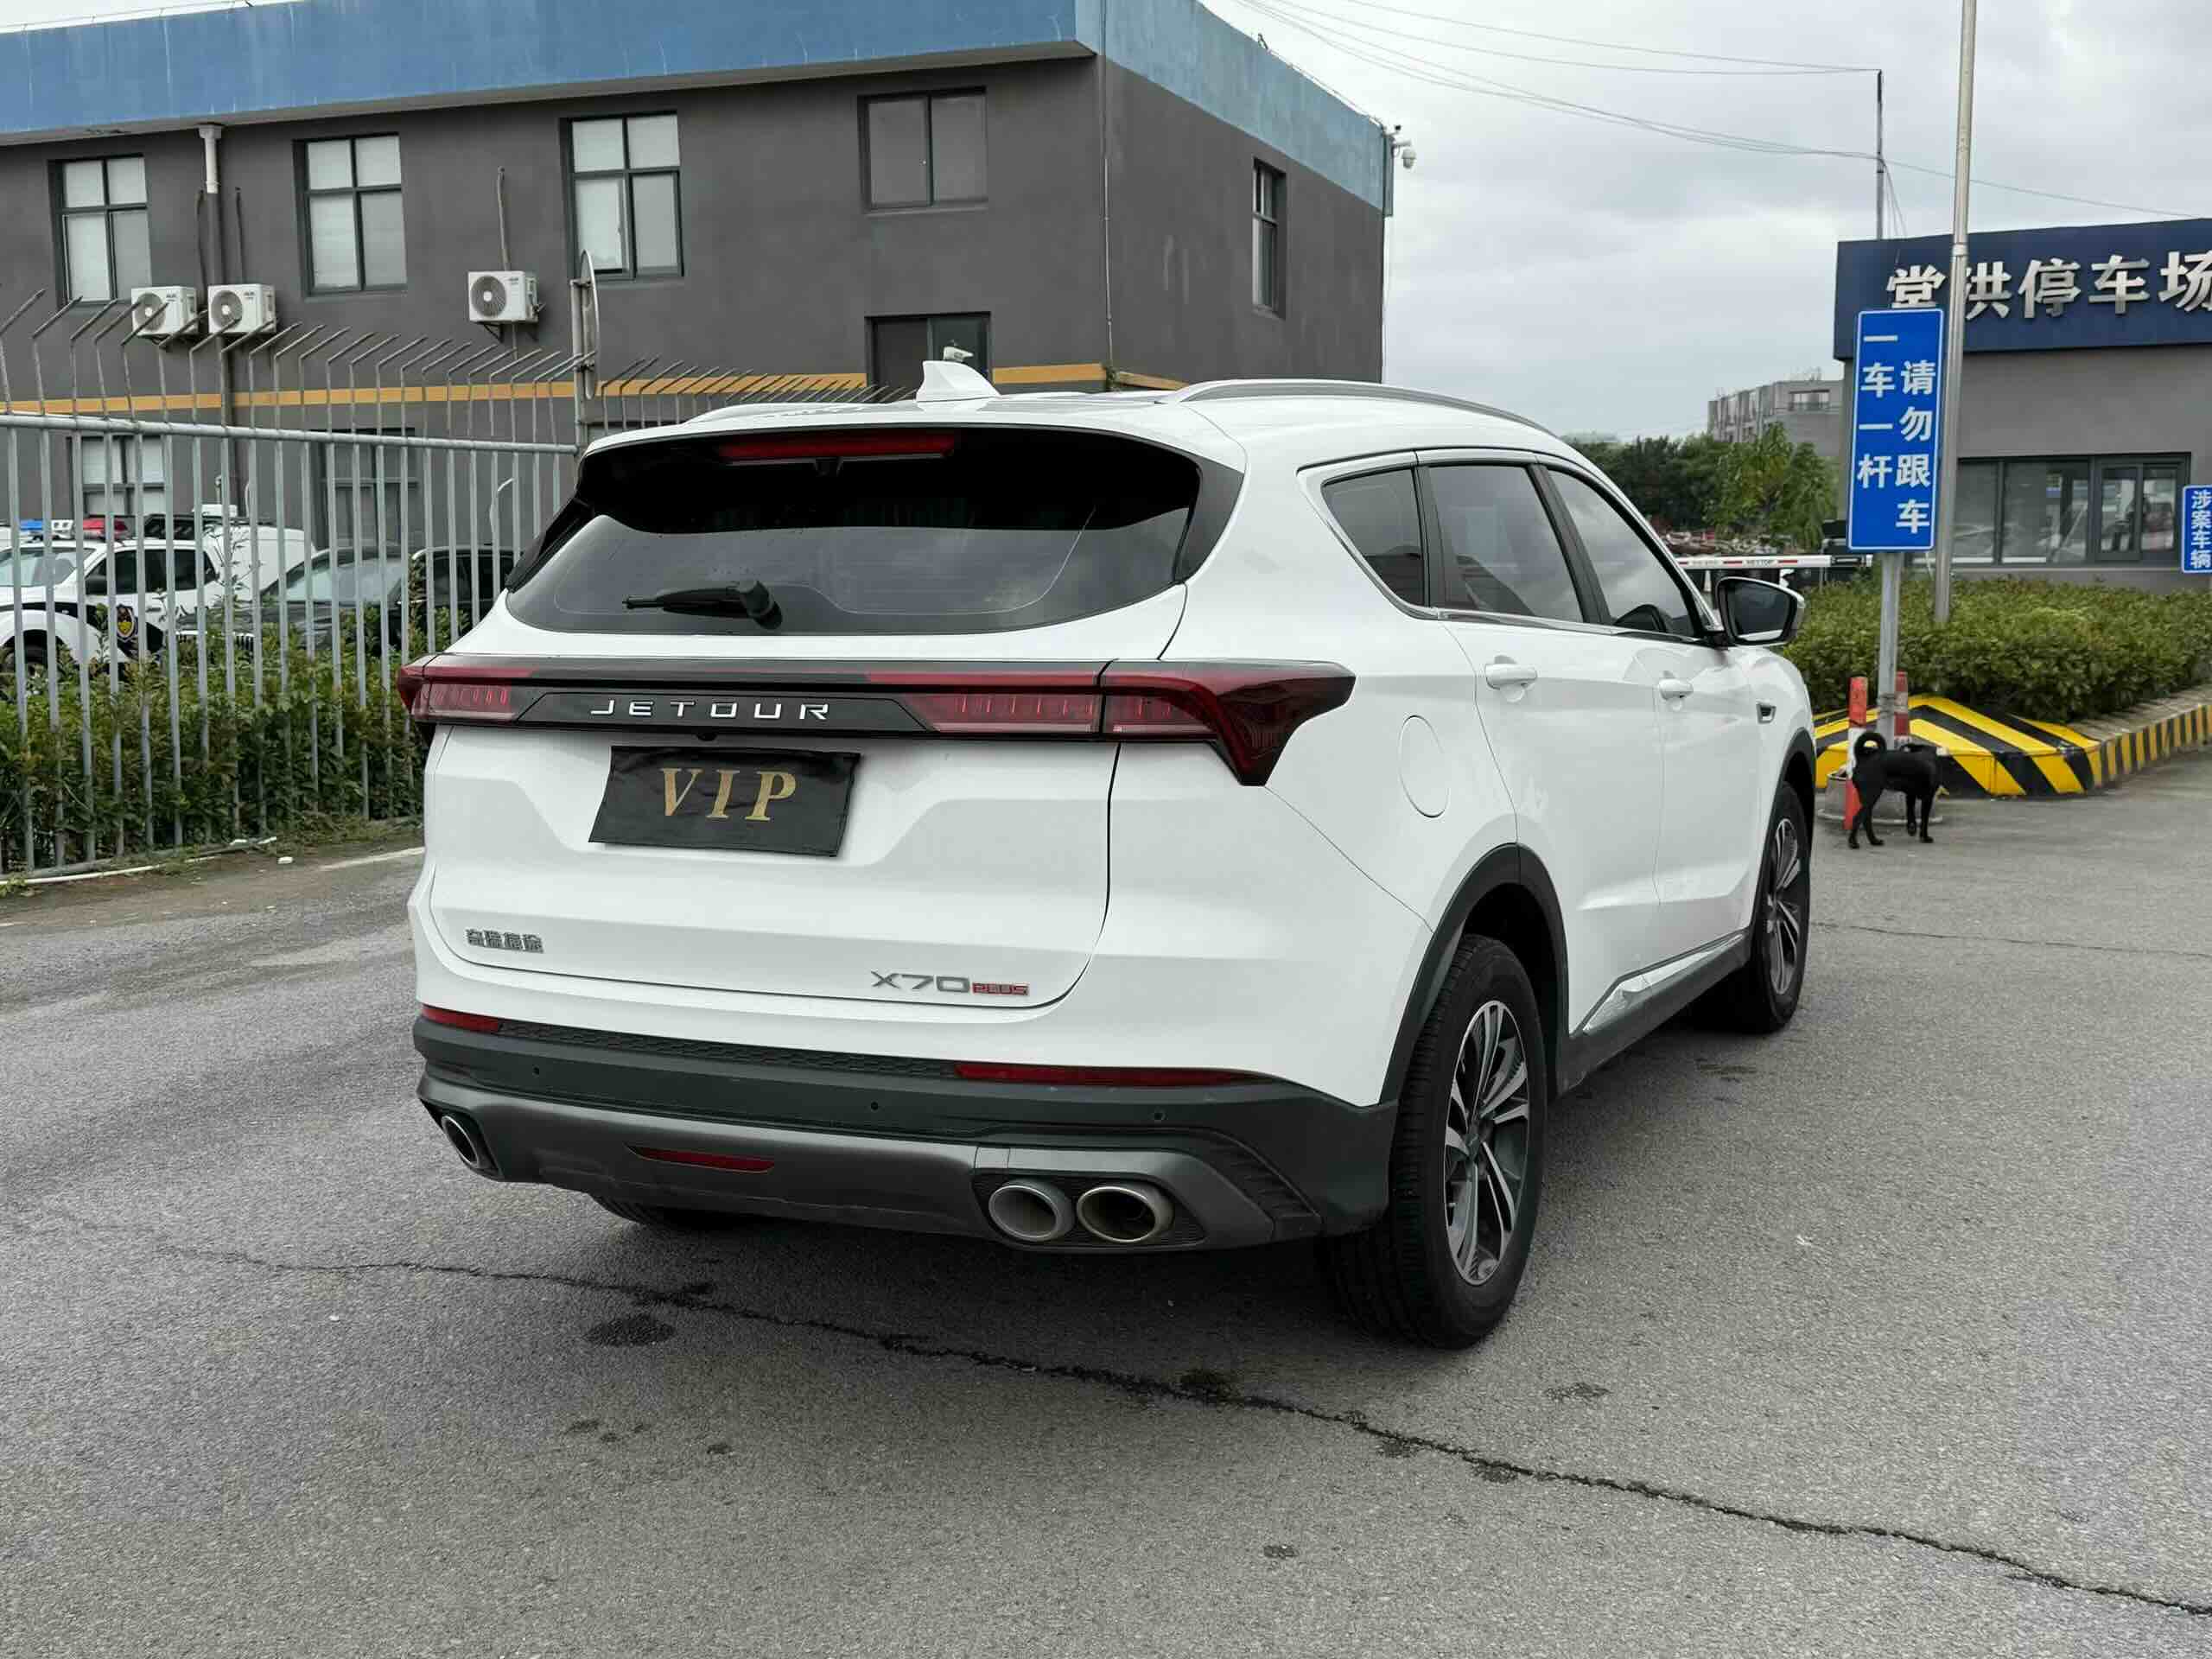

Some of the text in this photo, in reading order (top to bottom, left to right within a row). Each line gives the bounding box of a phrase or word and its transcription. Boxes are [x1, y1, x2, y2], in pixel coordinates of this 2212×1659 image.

[1857, 334, 1899, 489] 一车一杆
[1895, 359, 1936, 534] 请勿跟车
[590, 698, 829, 721] JETOUR
[659, 767, 797, 821] VIP
[870, 970, 970, 993] X70
